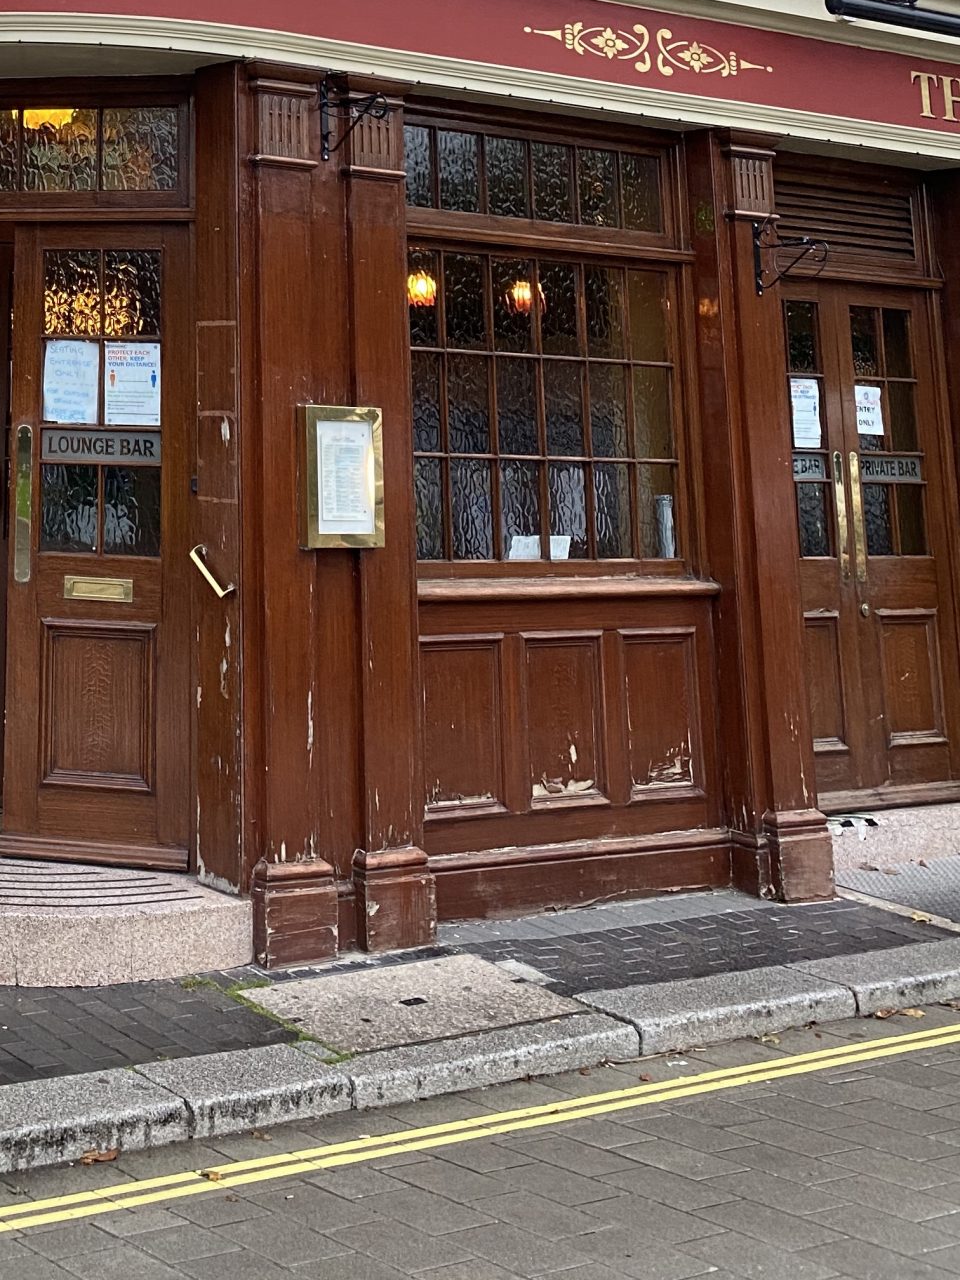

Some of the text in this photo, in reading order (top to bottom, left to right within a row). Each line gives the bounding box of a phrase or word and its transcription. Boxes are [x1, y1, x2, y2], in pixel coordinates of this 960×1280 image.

[48, 436, 155, 457] LOUNGE BAR
[897, 461, 918, 477] BAR
